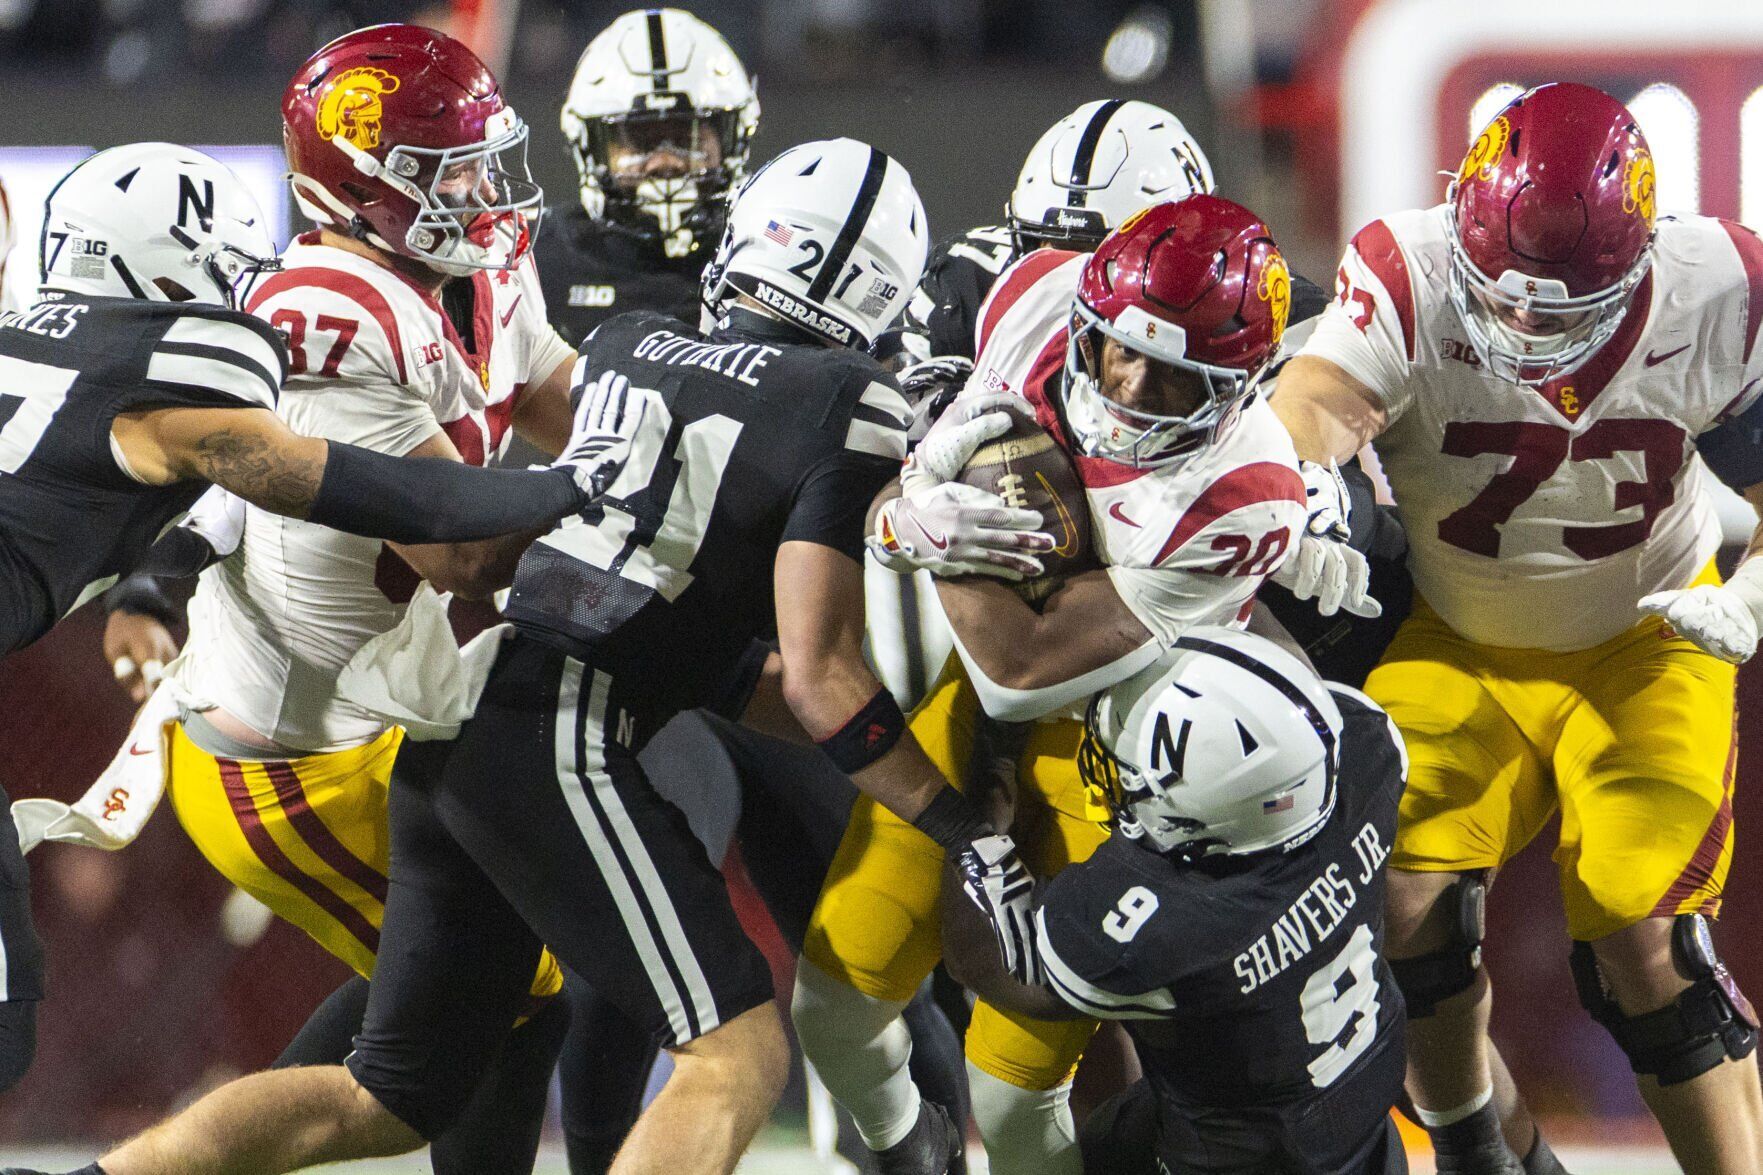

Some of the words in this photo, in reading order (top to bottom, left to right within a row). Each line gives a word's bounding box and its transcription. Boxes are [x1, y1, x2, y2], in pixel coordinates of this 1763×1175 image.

[177, 173, 214, 234] N
[754, 282, 851, 343] NEBRASKA
[1560, 386, 1579, 414] SC
[1437, 418, 1687, 562] 73
[616, 707, 636, 750] N
[1151, 711, 1193, 779] N
[1102, 885, 1159, 943] 9
[1233, 862, 1357, 994] SHAVERS
[1351, 822, 1391, 885] JR.
[1299, 923, 1381, 1089] 9
